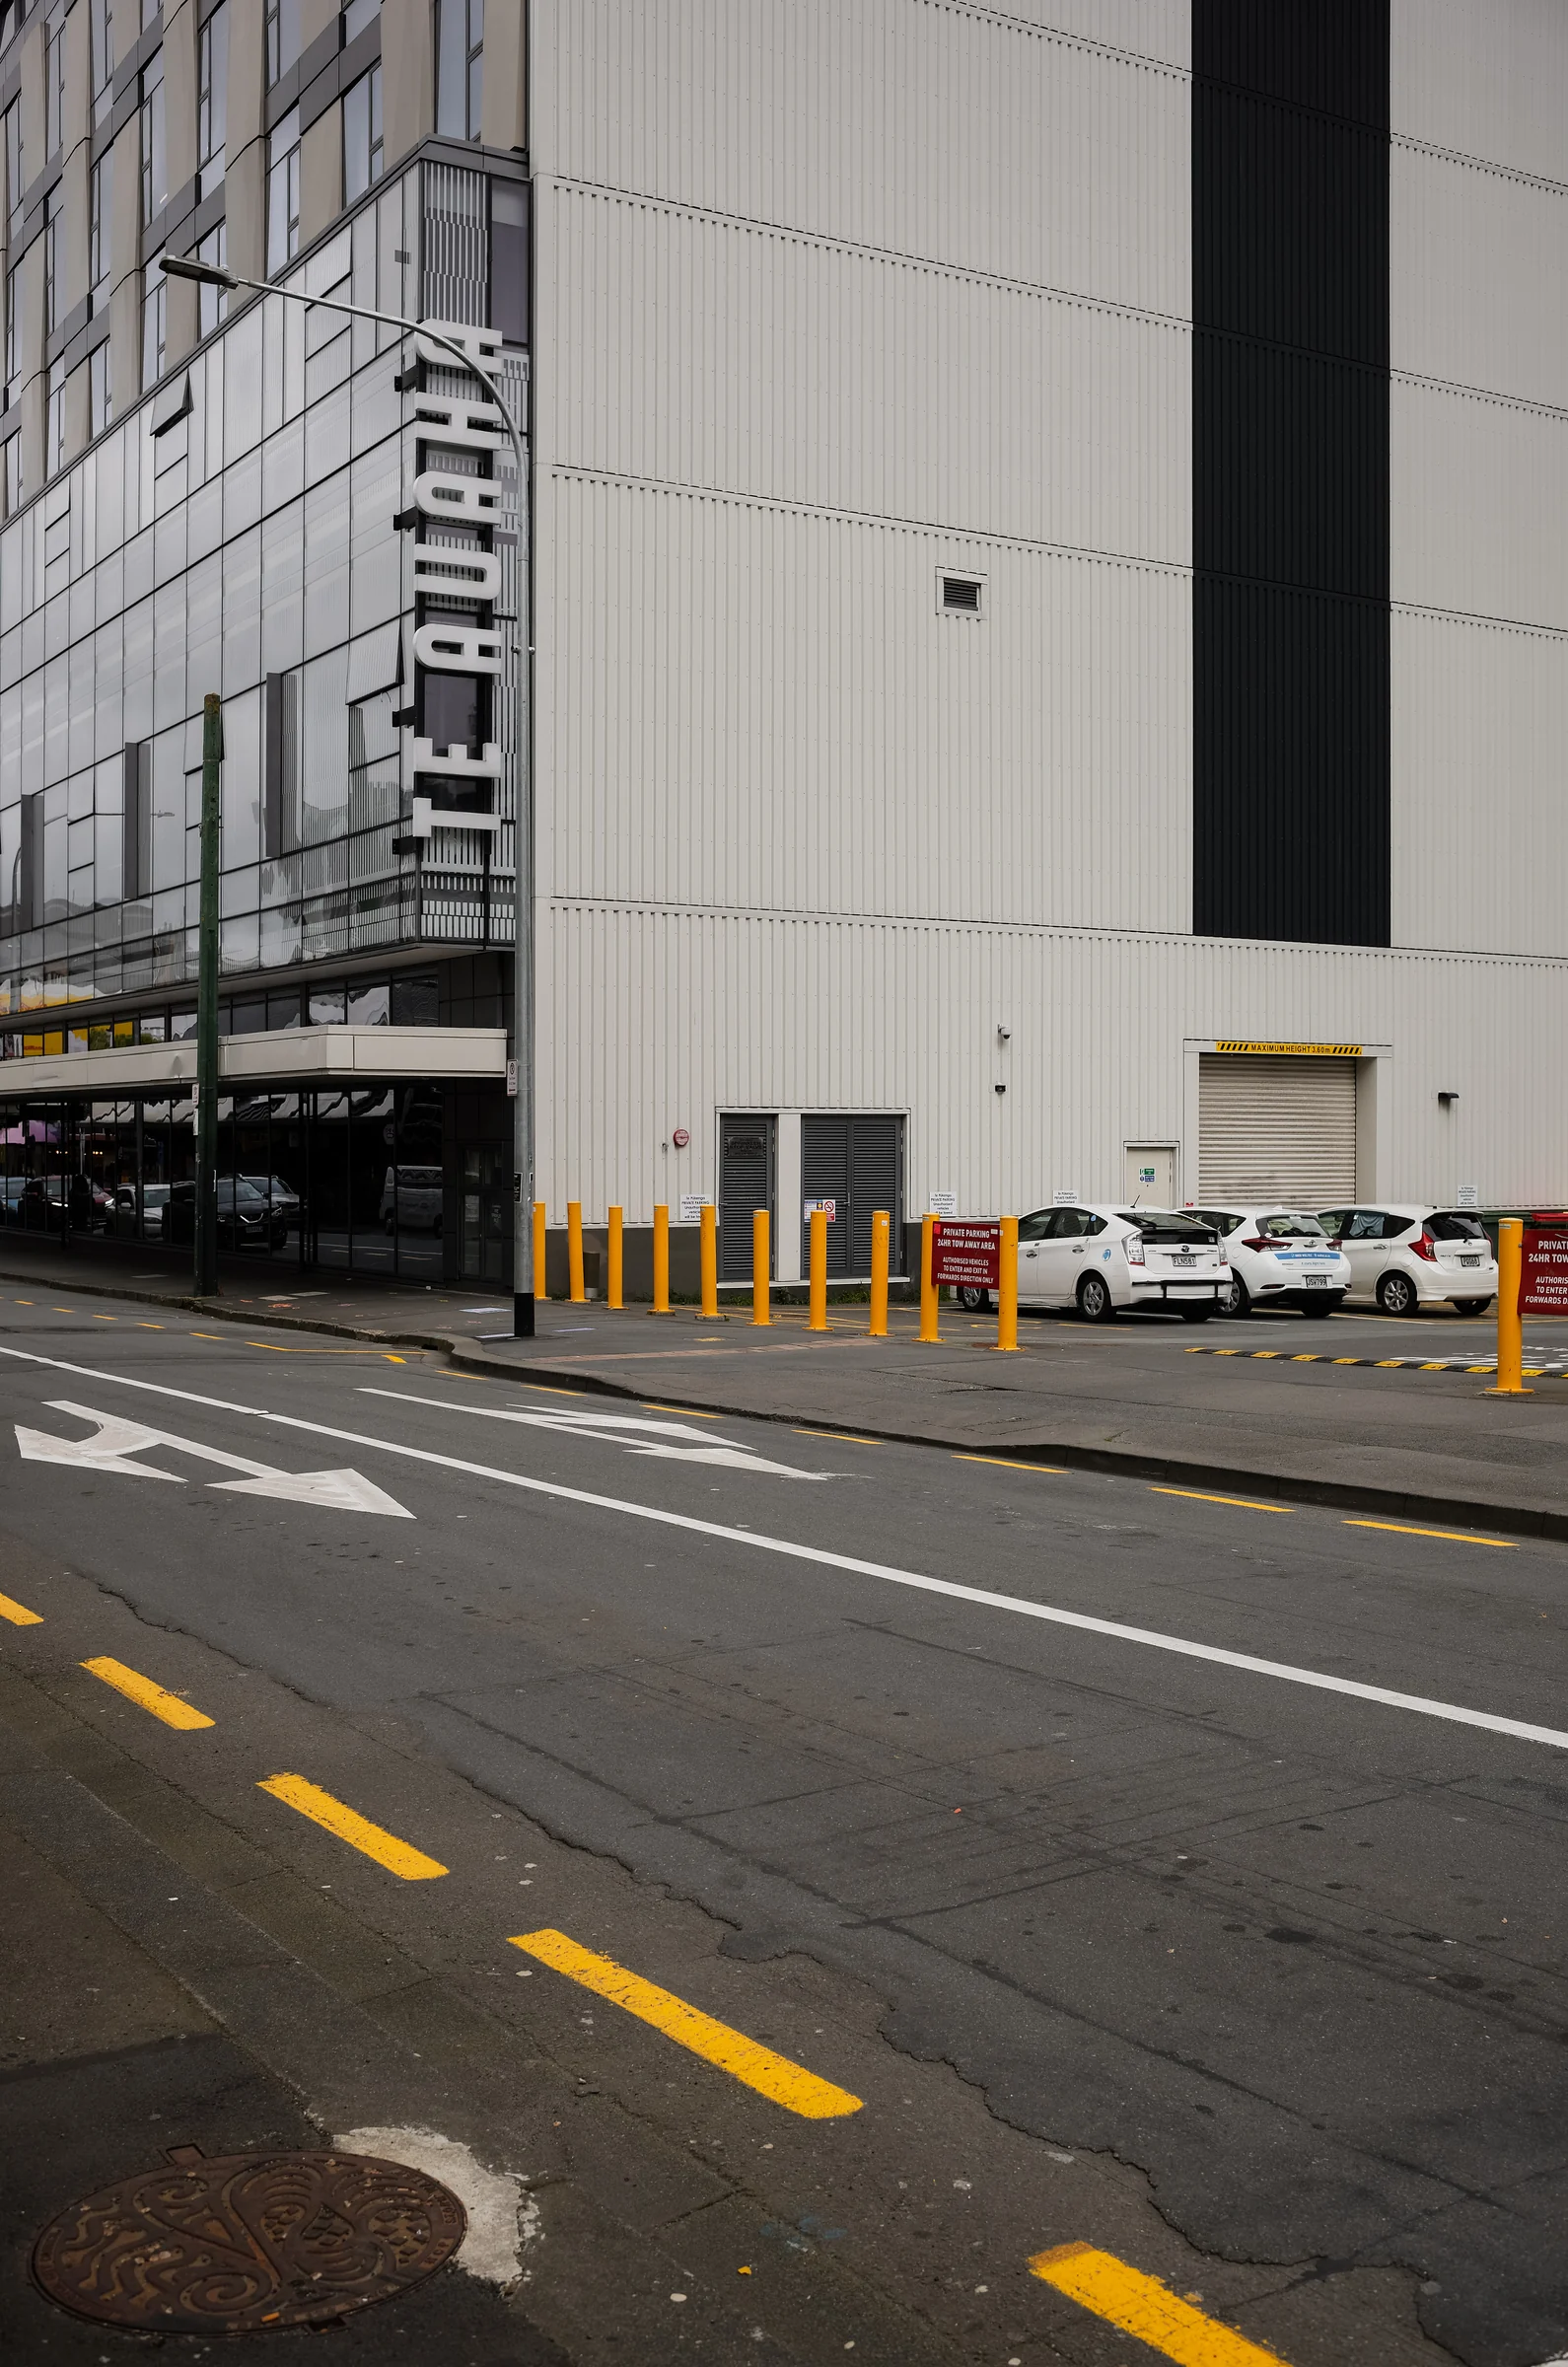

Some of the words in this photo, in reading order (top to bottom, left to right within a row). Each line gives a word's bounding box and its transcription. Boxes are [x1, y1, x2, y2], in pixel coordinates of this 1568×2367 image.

[413, 318, 503, 676] AUAHA
[413, 736, 502, 838] TE
[1250, 1044, 1284, 1052] MAXIMUM
[943, 1227, 965, 1237] PRIVATE
[966, 1229, 990, 1238] PARKING
[937, 1239, 951, 1247] 24HR
[952, 1240, 964, 1248] TOW
[965, 1241, 981, 1249] AWAY
[981, 1242, 995, 1250] AREA
[1538, 1241, 1568, 1250] PRIVAT
[1528, 1253, 1550, 1263] 24HR
[1525, 1296, 1562, 1304] FORWARDS
